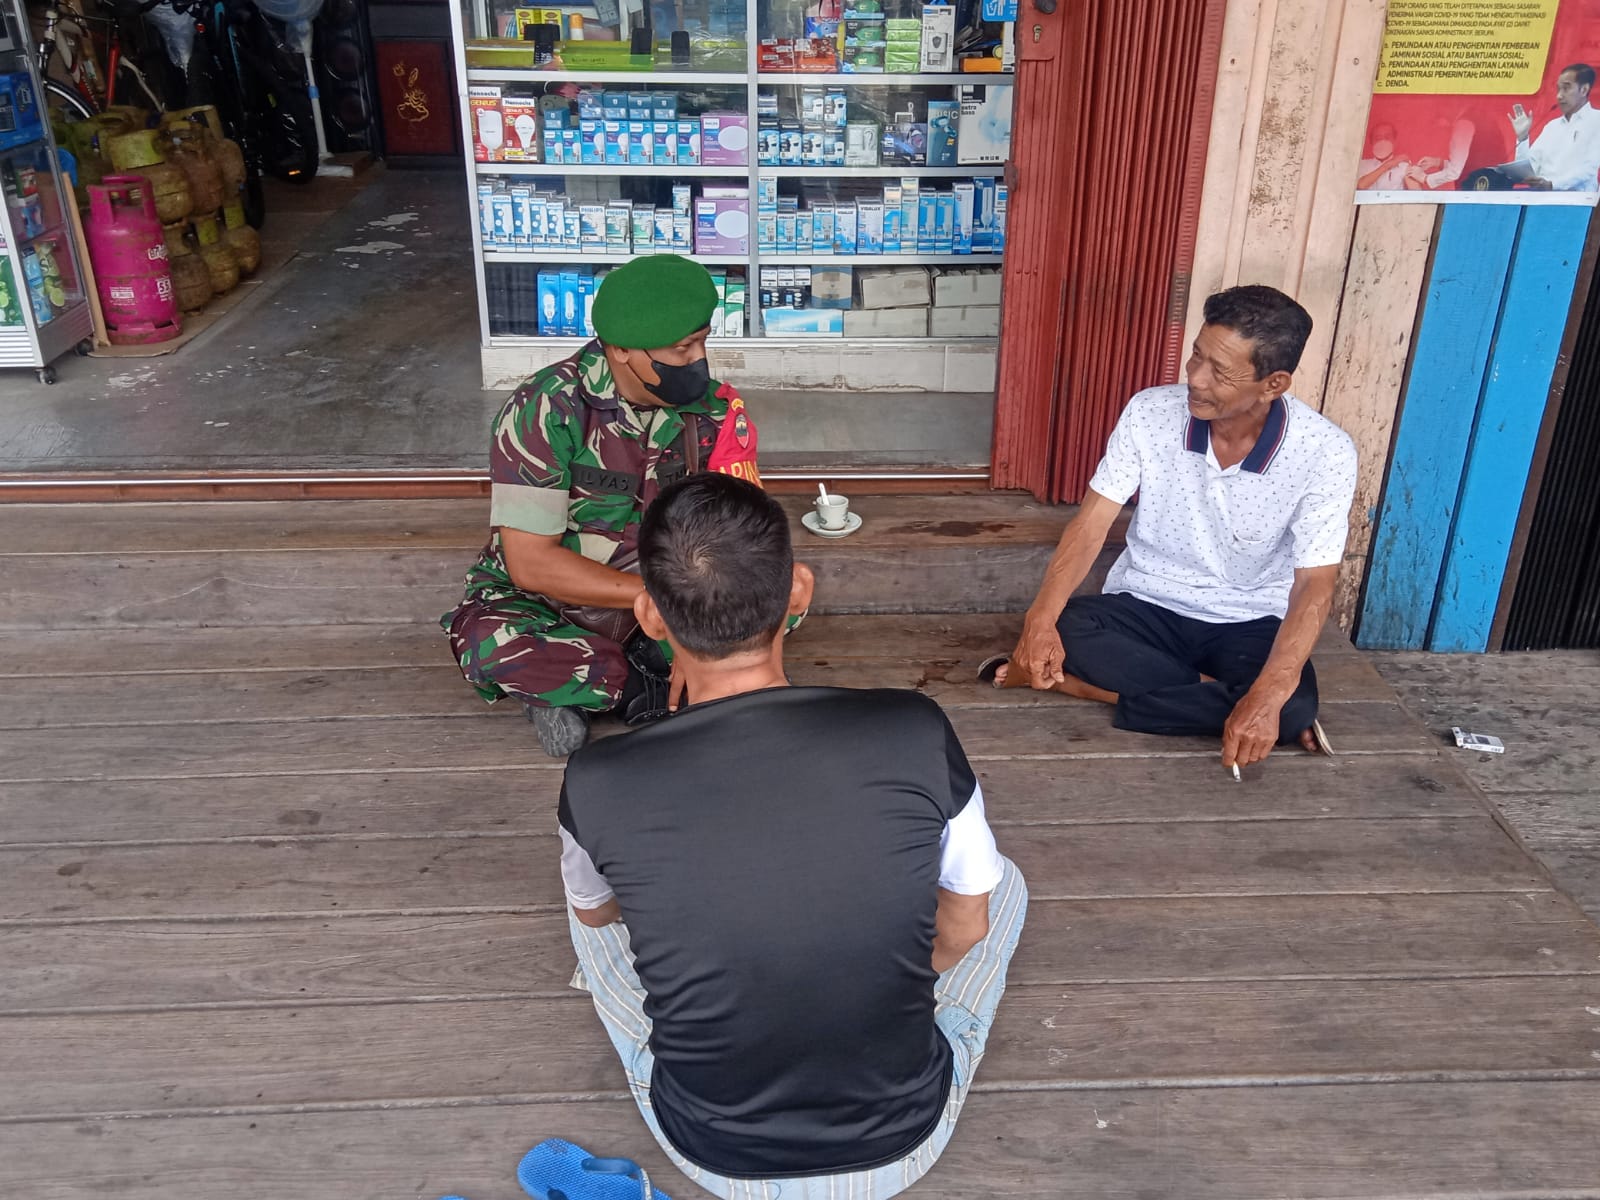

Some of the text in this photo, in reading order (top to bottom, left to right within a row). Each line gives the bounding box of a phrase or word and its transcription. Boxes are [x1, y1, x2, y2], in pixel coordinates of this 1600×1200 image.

[1422, 51, 1445, 59] SOSIAL
[1446, 51, 1465, 59] ATAU
[1498, 61, 1529, 69] LAYANAN
[1387, 70, 1434, 78] ADMINISTRASI
[1385, 79, 1409, 87] DENDA.
[579, 470, 629, 491] ILYAS
